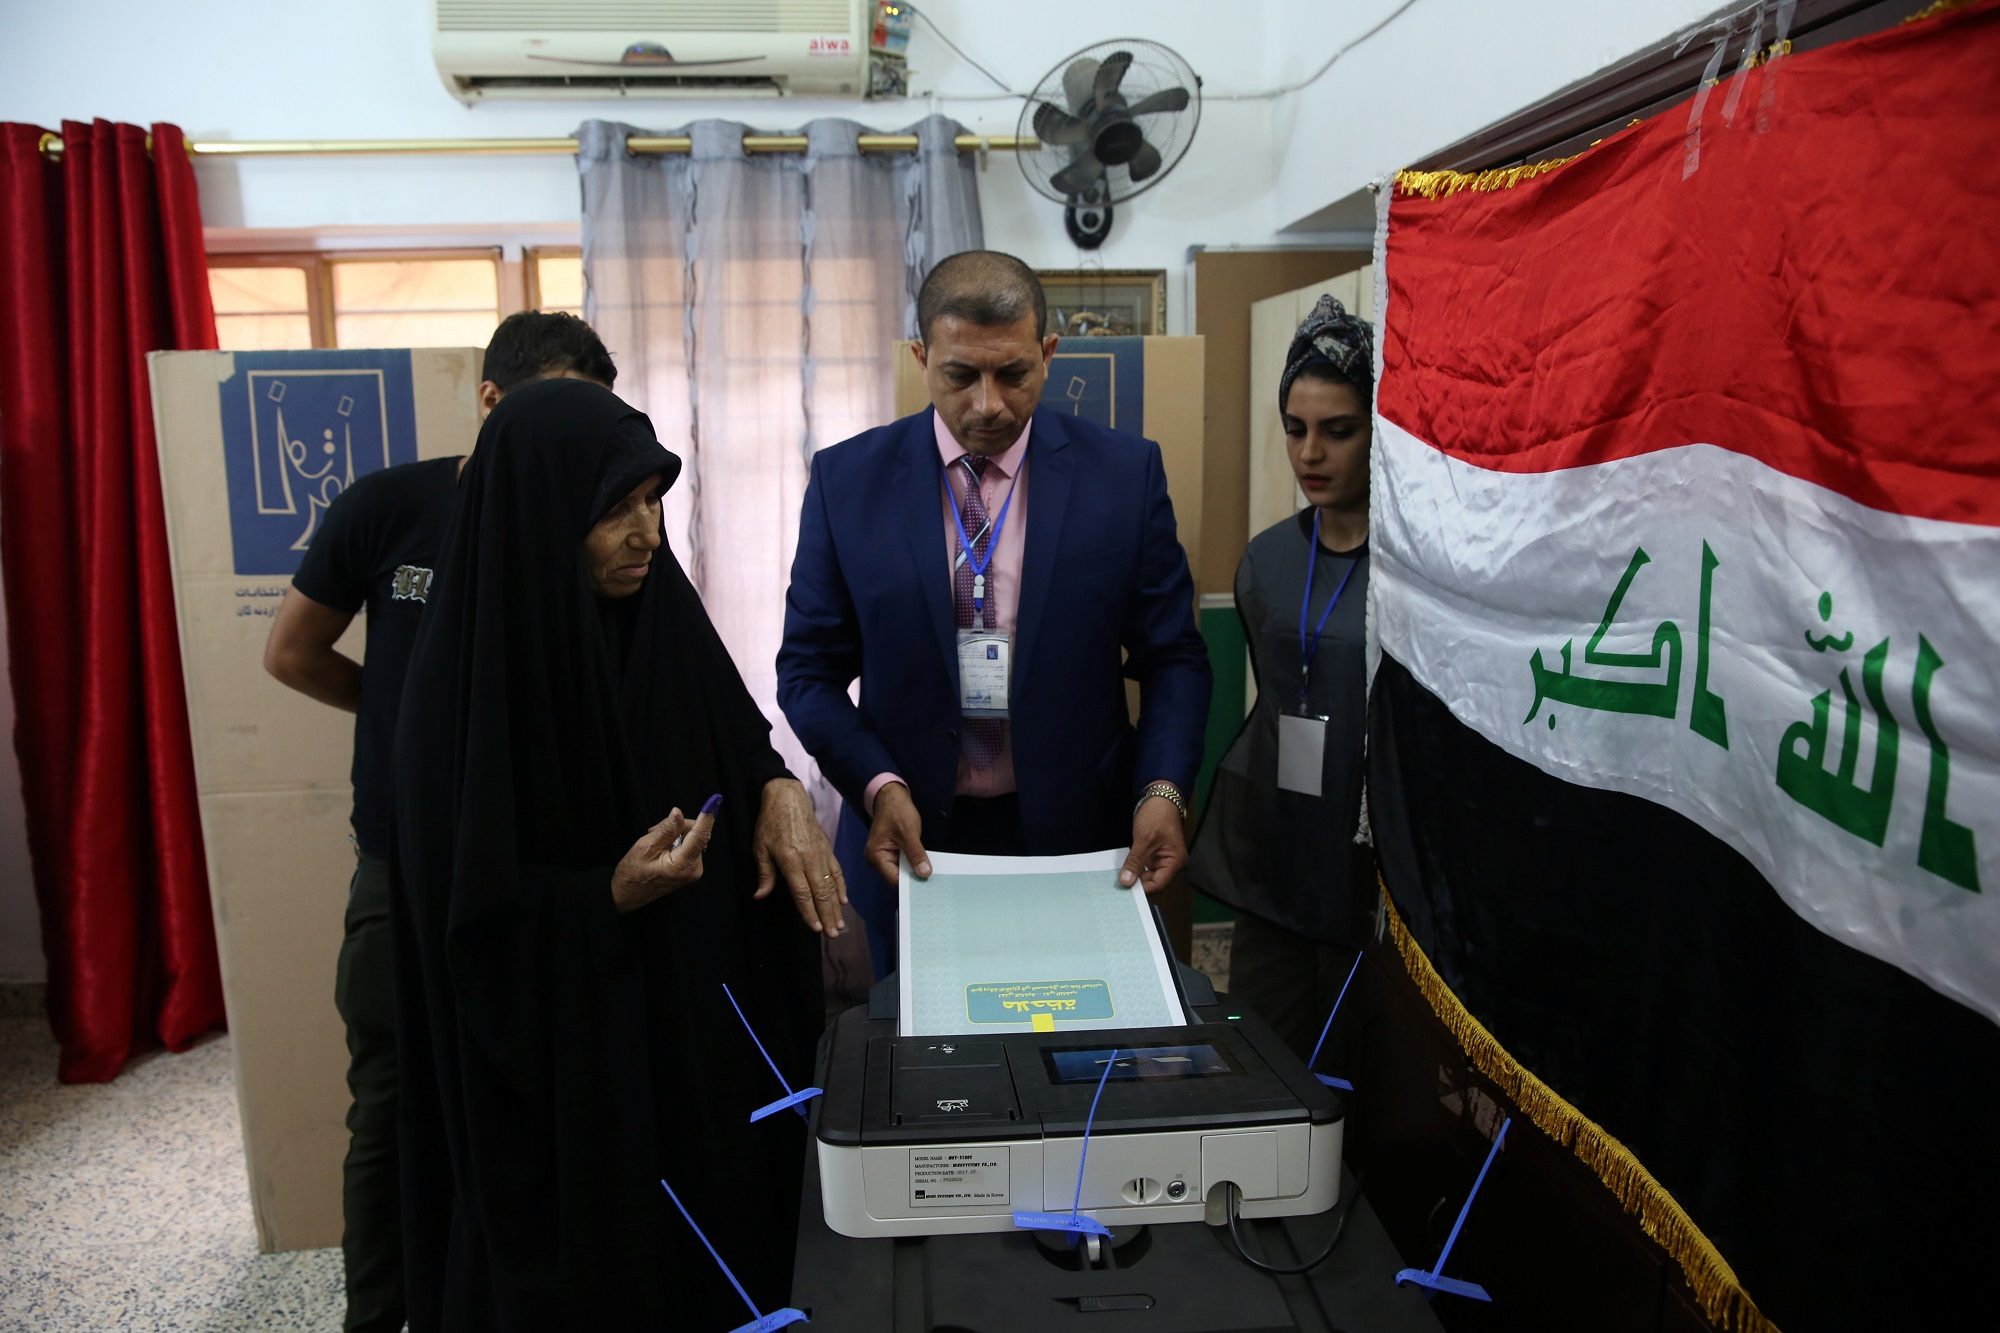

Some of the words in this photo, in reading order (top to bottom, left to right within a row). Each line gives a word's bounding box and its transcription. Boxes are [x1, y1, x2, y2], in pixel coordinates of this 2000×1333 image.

[809, 36, 849, 50] aiwa
[1776, 591, 1982, 894] الله
[1002, 1000, 1076, 1012] ملاحظة
